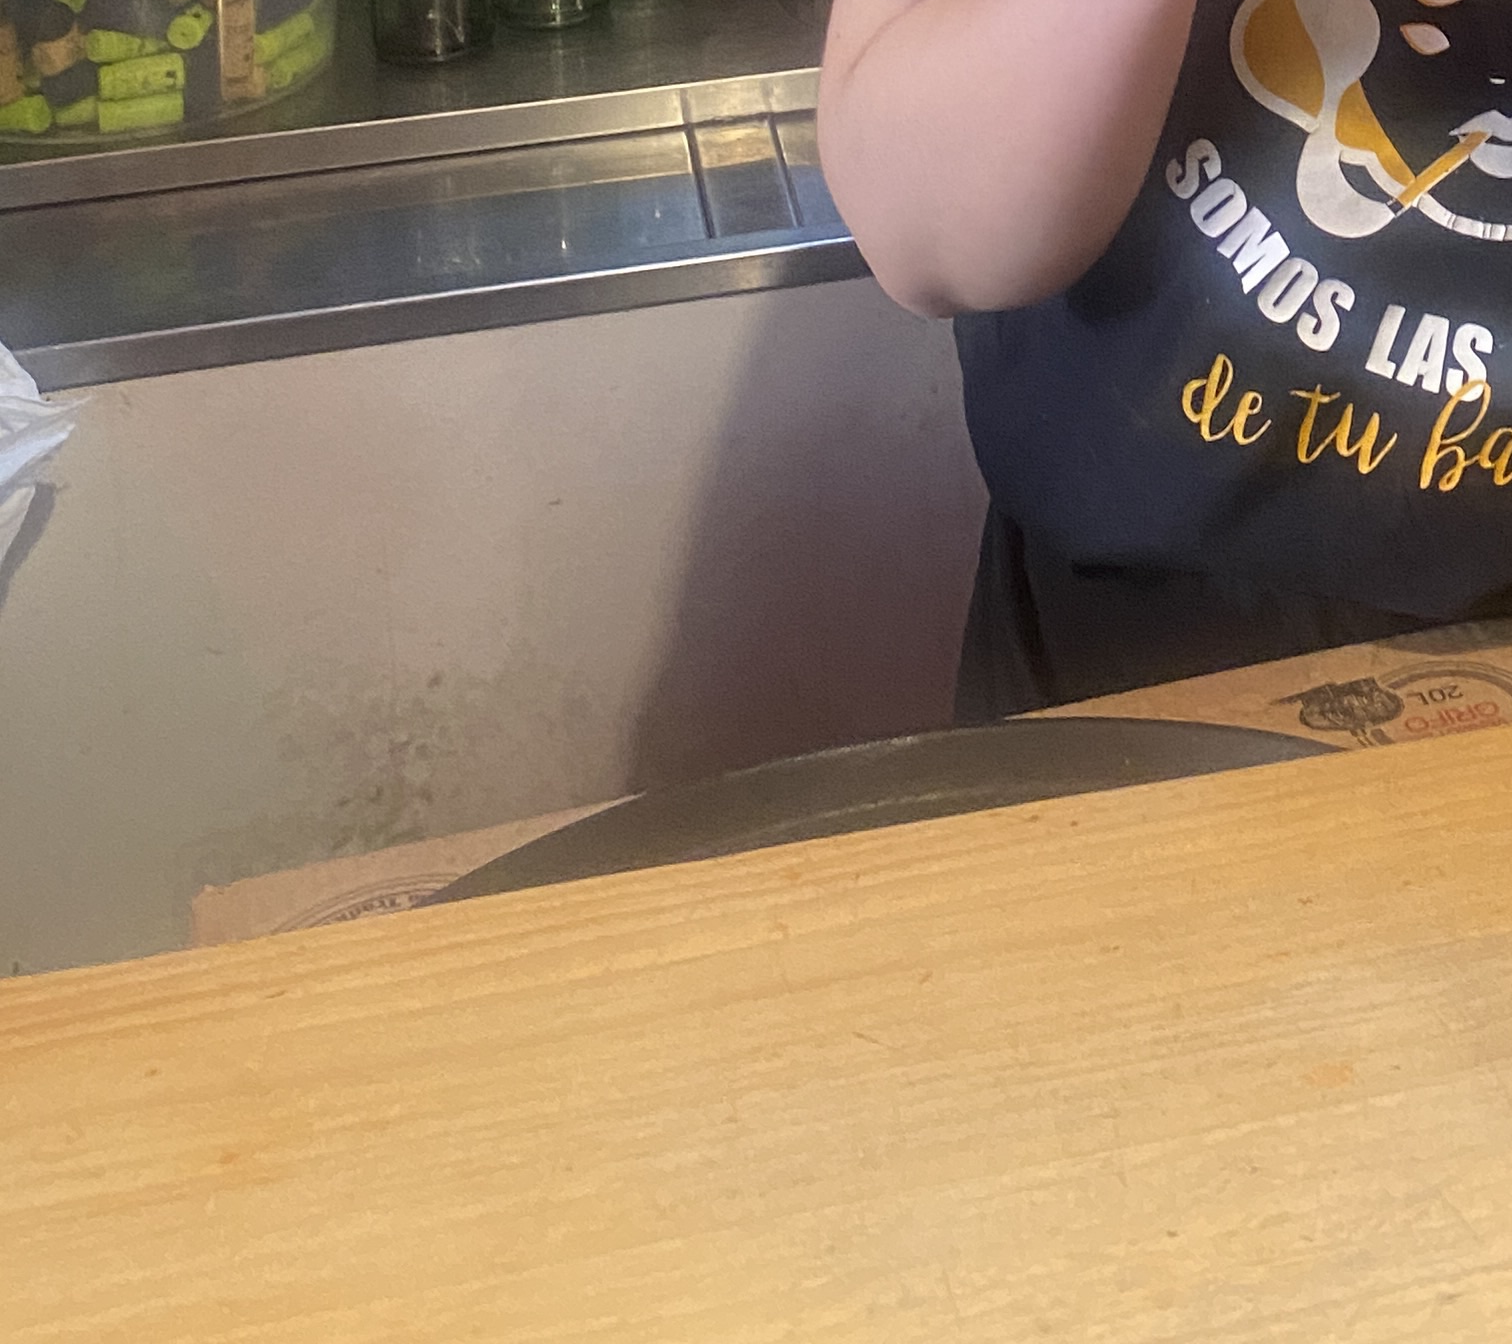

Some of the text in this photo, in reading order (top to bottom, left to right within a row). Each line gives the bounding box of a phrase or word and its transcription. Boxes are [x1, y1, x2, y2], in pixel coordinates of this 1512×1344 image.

[1165, 138, 1357, 352] SOMOS
[1364, 304, 1494, 401] LAS
[1181, 353, 1272, 445] de
[1290, 383, 1398, 475] tu
